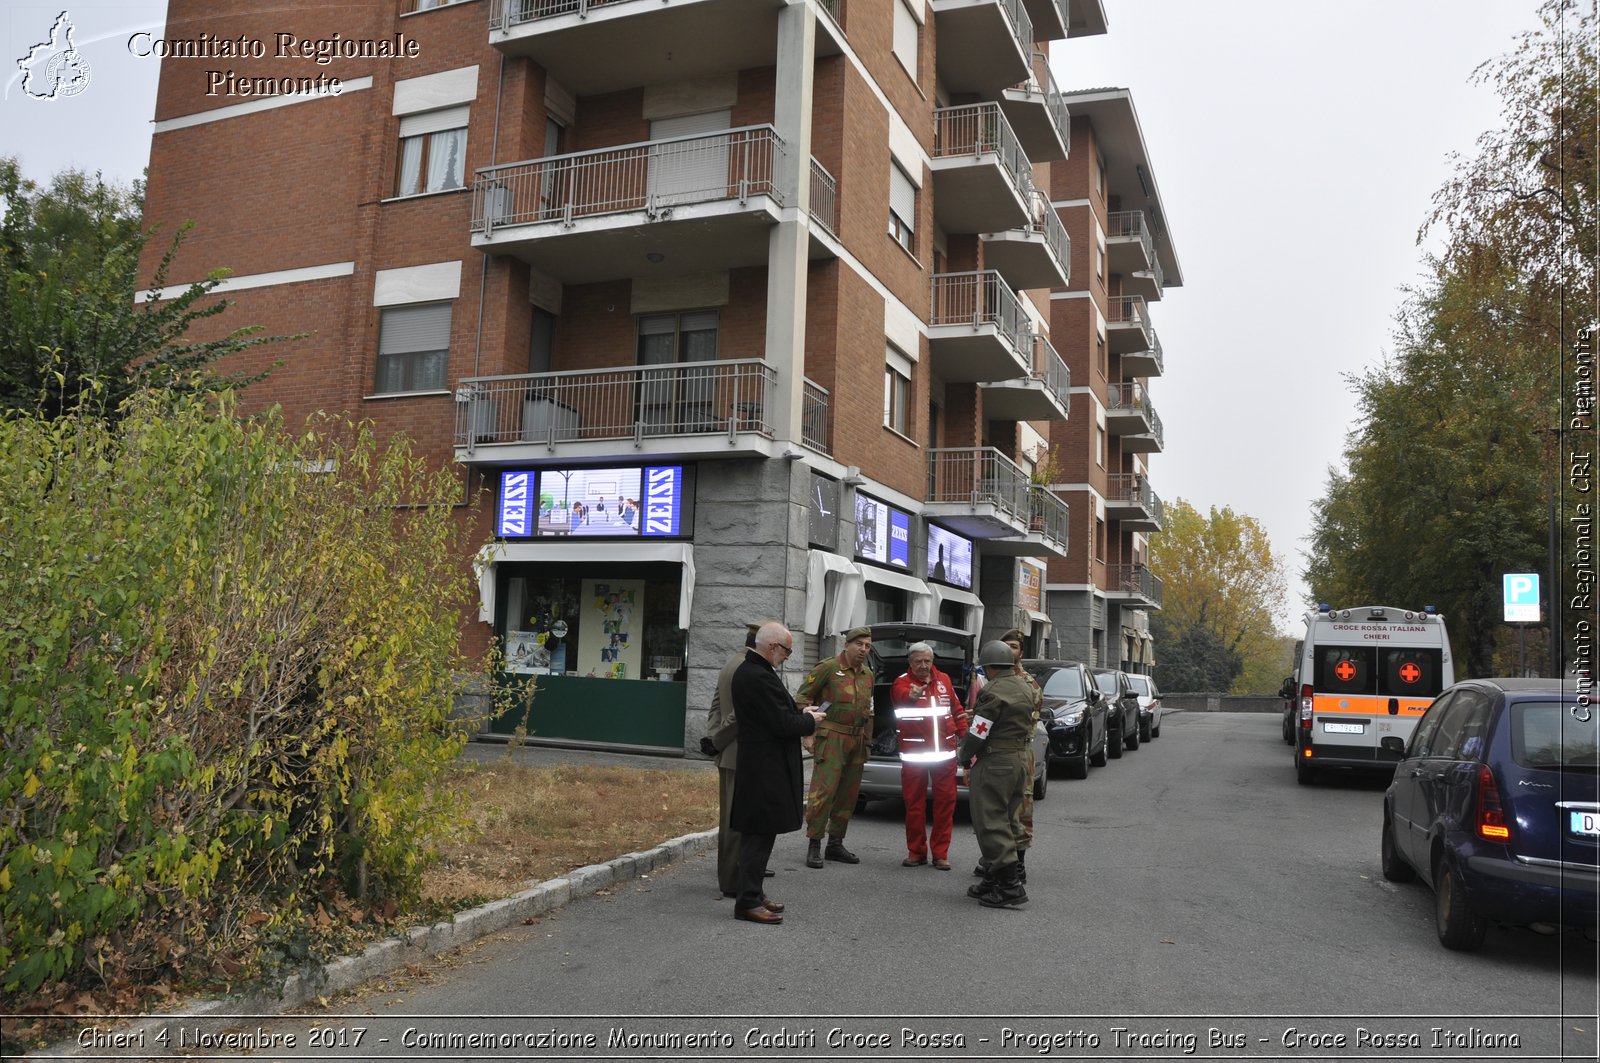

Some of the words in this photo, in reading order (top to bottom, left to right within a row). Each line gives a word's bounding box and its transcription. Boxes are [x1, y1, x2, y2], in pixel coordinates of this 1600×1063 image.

[501, 473, 529, 535] ZEISS
[646, 468, 675, 534] ZEISS
[1511, 577, 1532, 602] P
